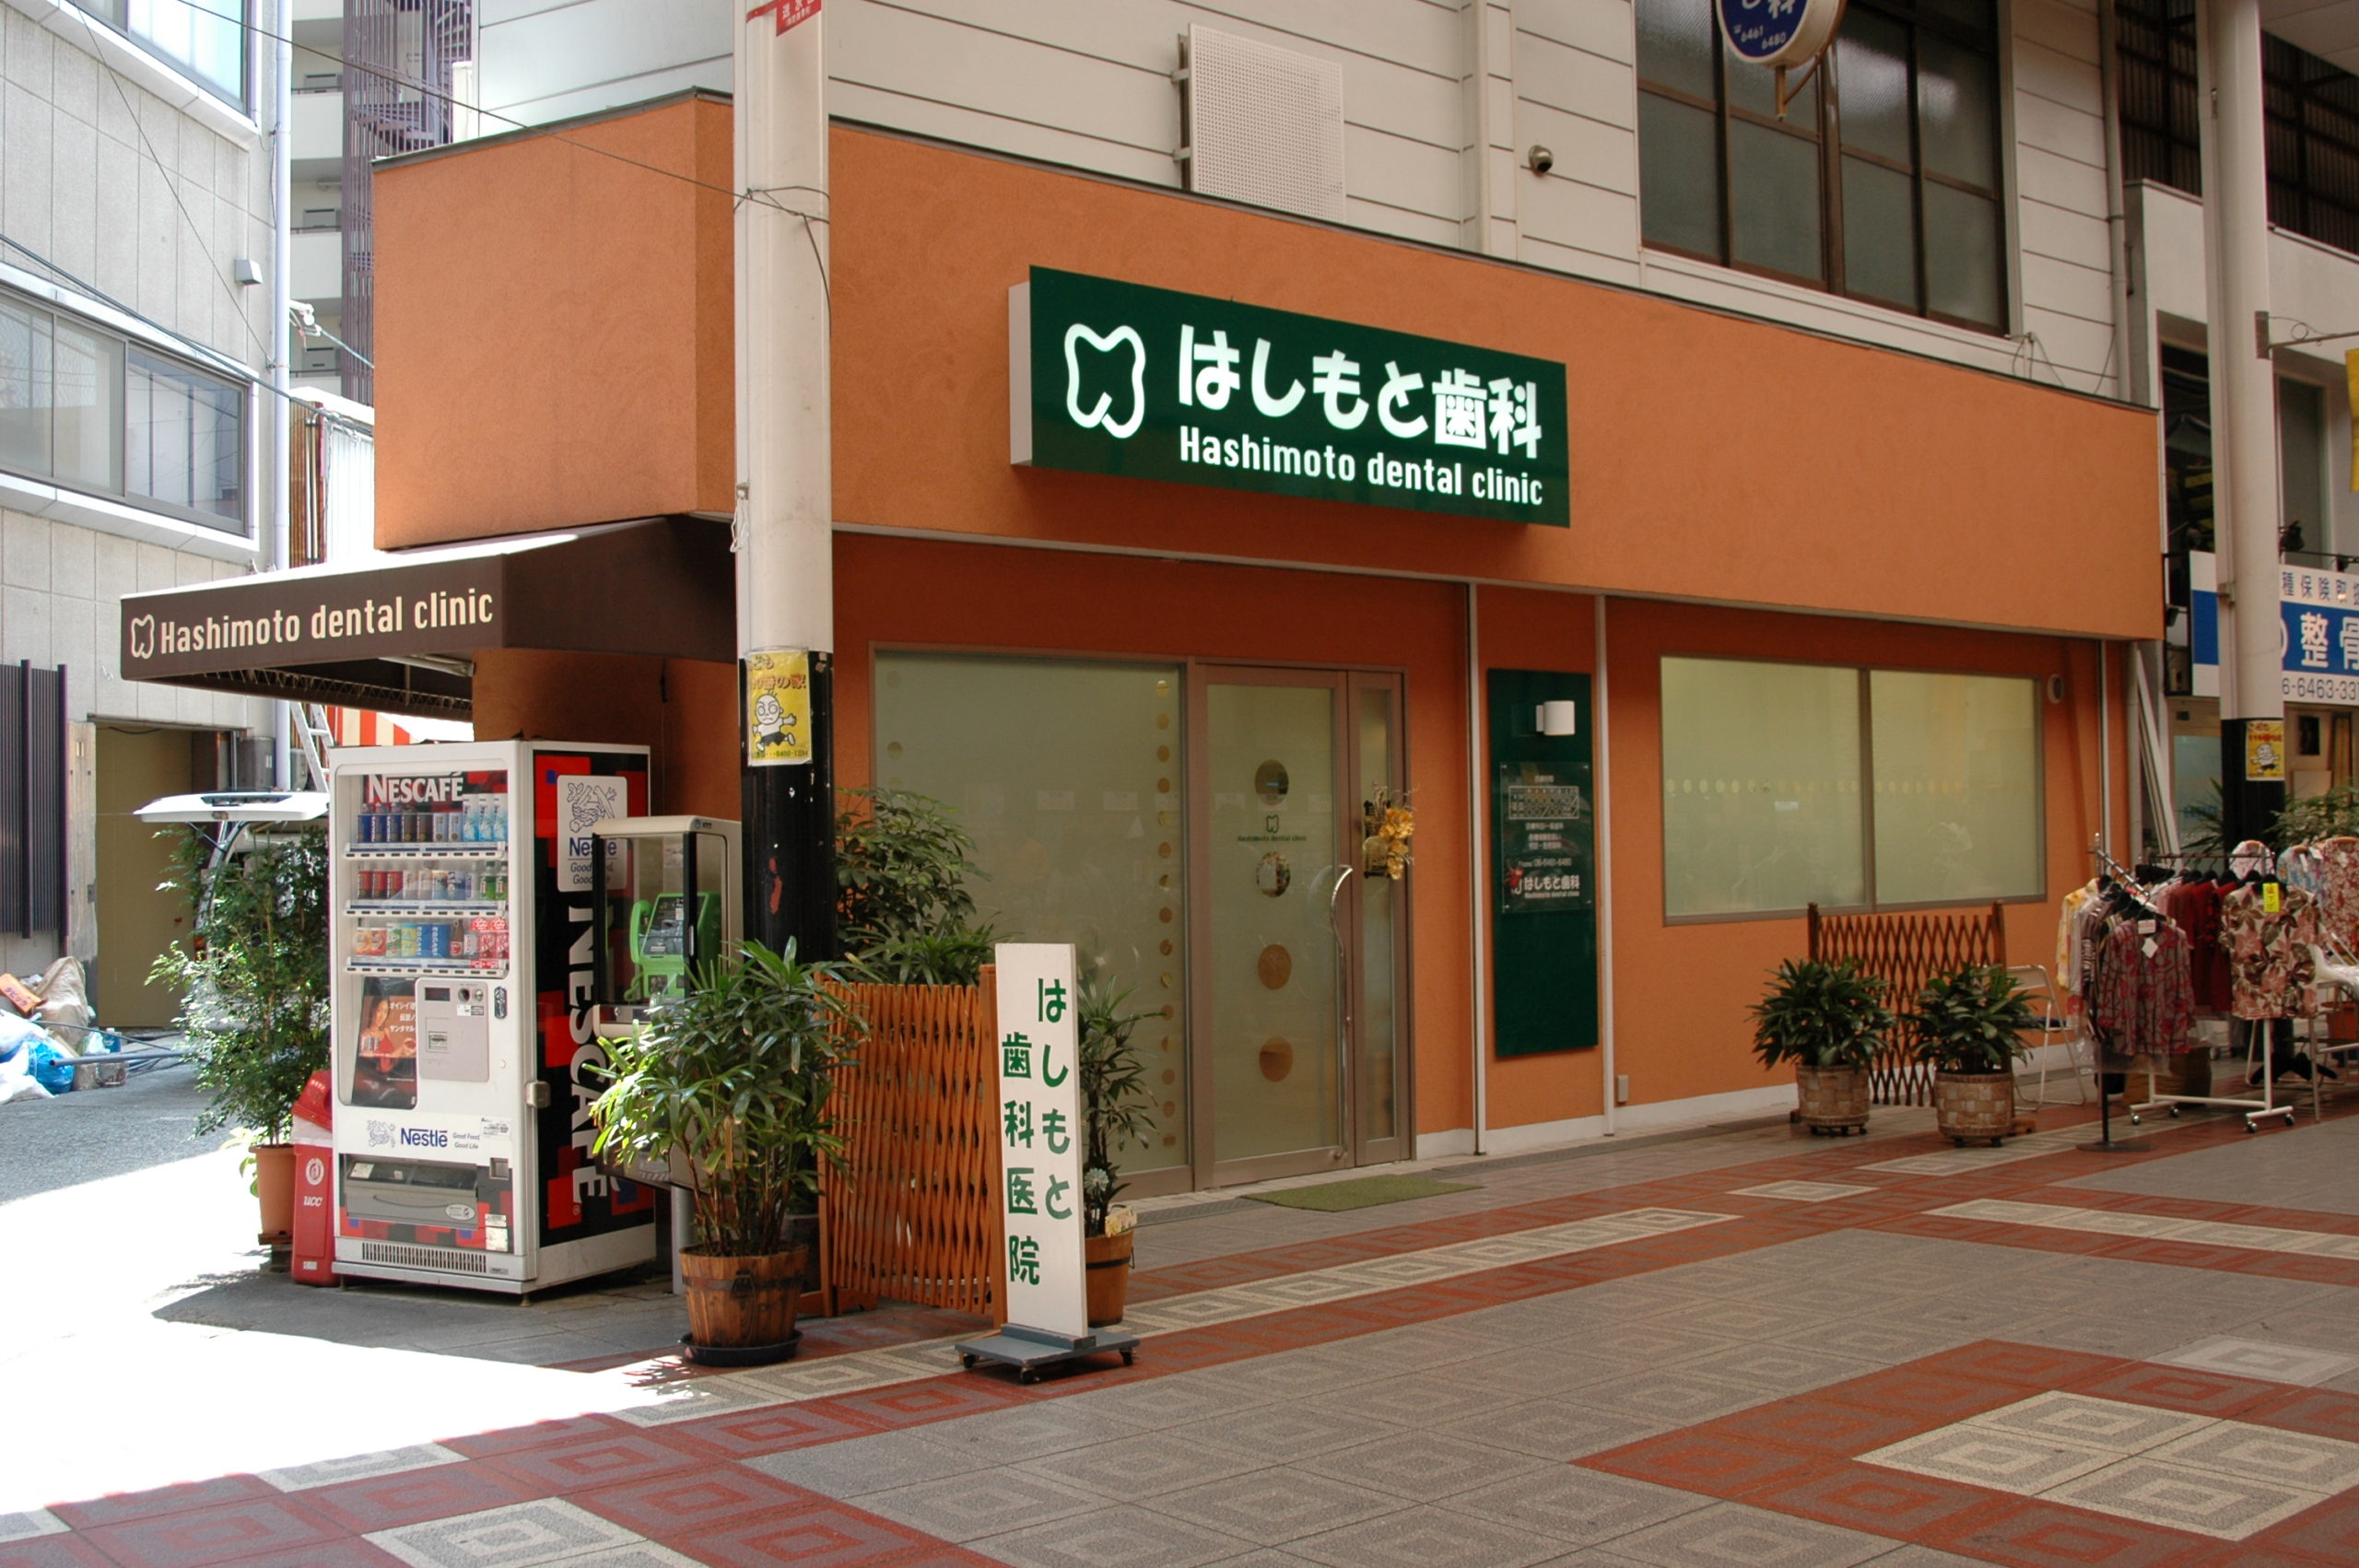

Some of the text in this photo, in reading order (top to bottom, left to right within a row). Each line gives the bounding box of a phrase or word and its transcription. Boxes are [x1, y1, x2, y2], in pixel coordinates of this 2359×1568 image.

[1179, 324, 1543, 459] はしもと歯科
[1180, 426, 1543, 506] Hashimoto dental clinic
[160, 588, 493, 654] Hashimoto dental clinic
[2282, 677, 2359, 700] 6-6463-33
[369, 771, 464, 803] NESCAFÉ
[1524, 874, 1580, 891] はしもと歯科
[1038, 977, 1074, 1220] はしもと
[401, 1128, 448, 1148] Nestlé
[1002, 1031, 1040, 1286] 歯科医院
